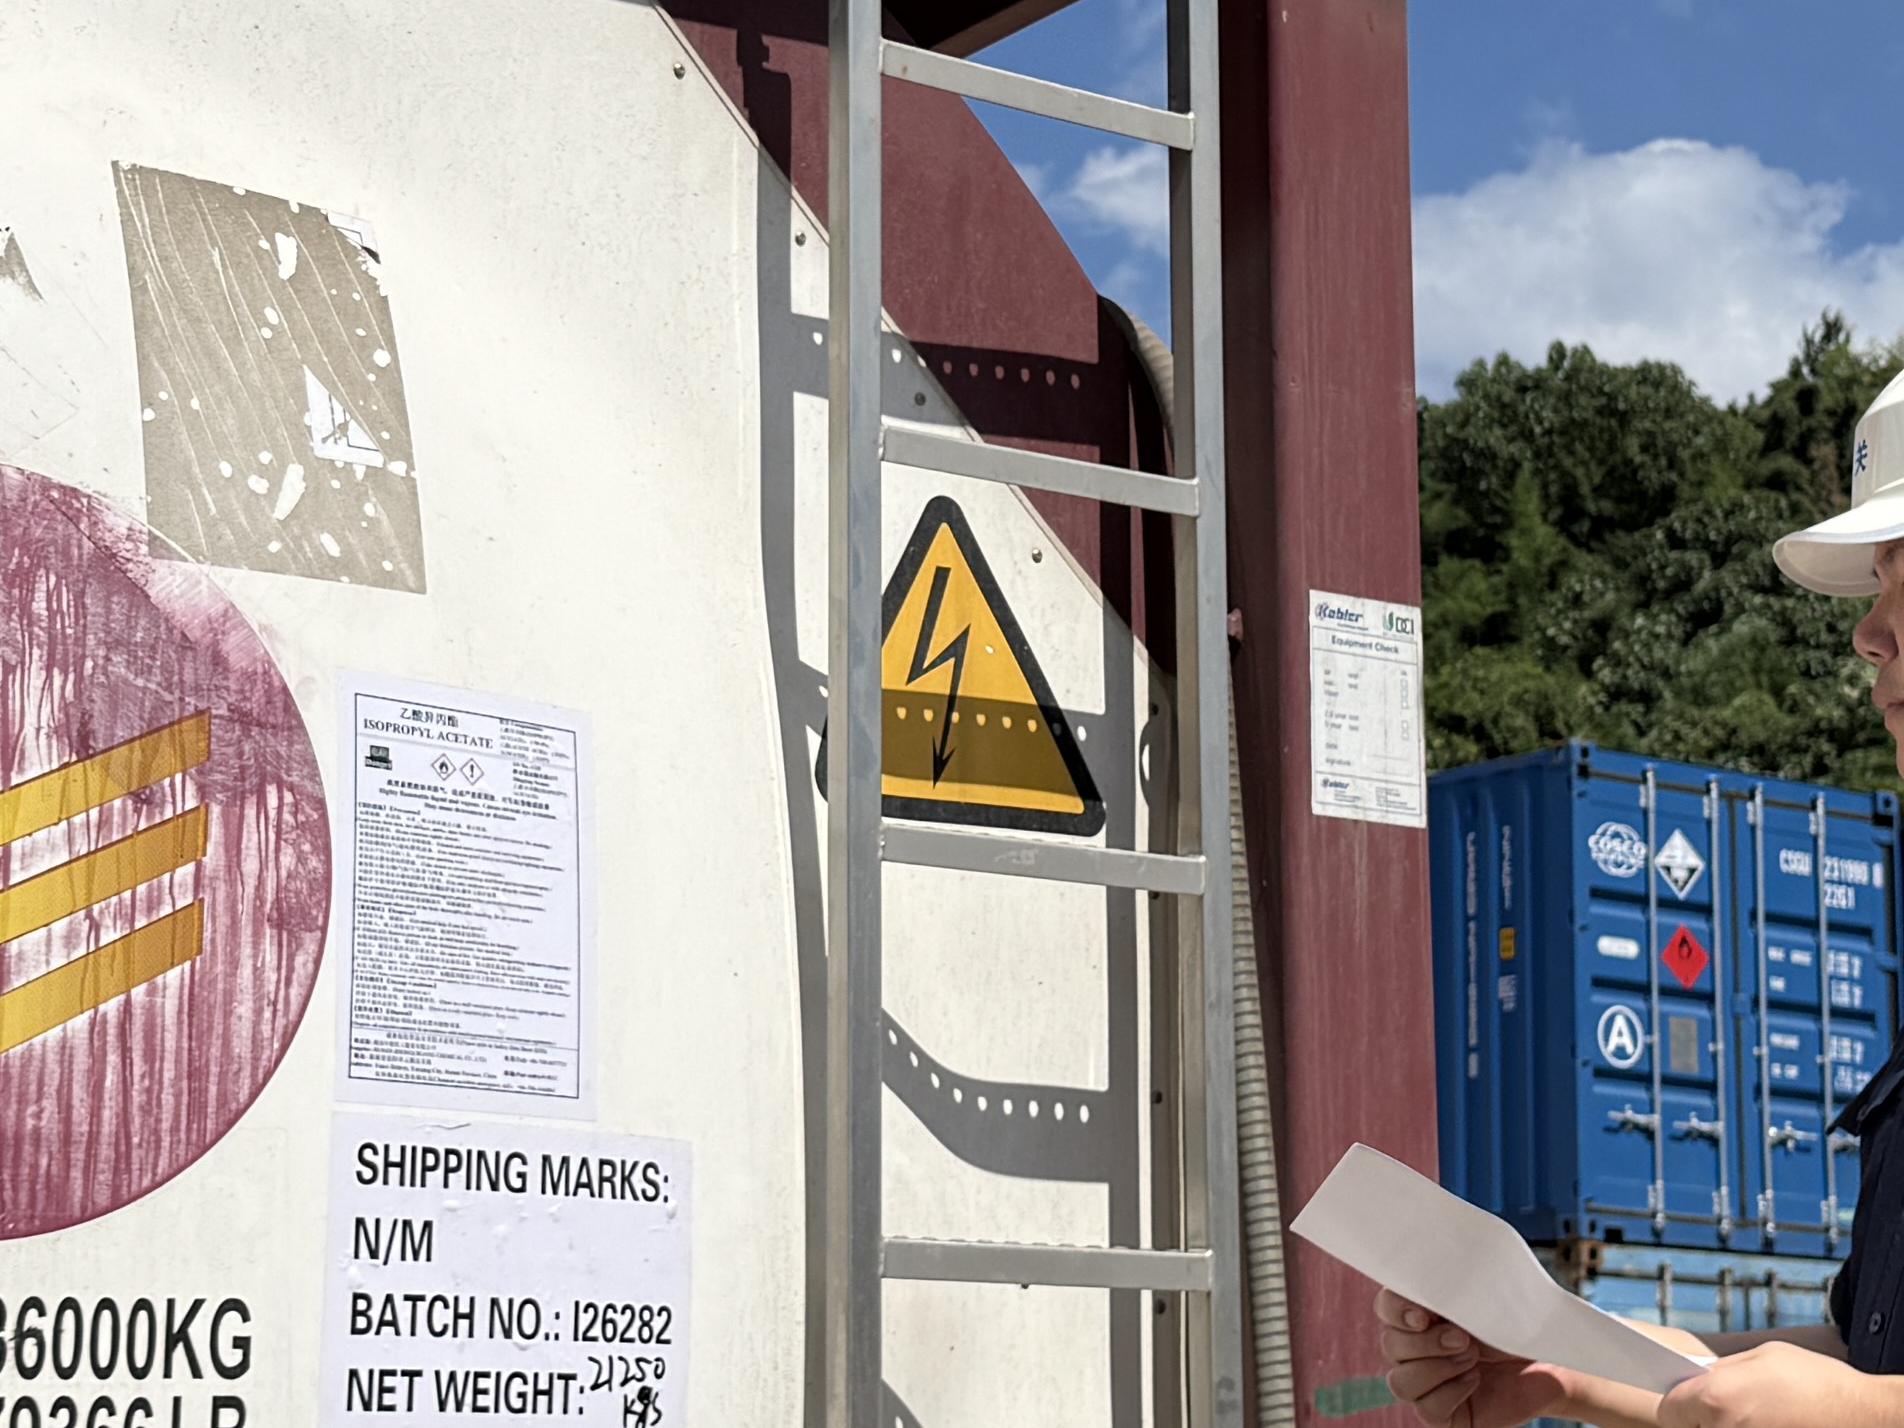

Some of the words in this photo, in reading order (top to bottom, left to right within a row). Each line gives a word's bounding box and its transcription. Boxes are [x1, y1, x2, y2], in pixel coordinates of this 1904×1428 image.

[1331, 635, 1373, 650] Equipment
[1375, 642, 1399, 654] Check
[363, 718, 434, 740] ISOPROPYL
[438, 731, 494, 749] ACETATE
[1588, 835, 1647, 855] COSCO
[1607, 1014, 1635, 1058] A
[355, 1142, 529, 1194] SHIPPING
[540, 1154, 669, 1203] MARKS:
[353, 1217, 434, 1265] N/M
[350, 1292, 476, 1339] BATCH
[488, 1297, 561, 1341] NO.:
[346, 1368, 423, 1412] NET
[434, 1370, 585, 1415] WEIGHT:
